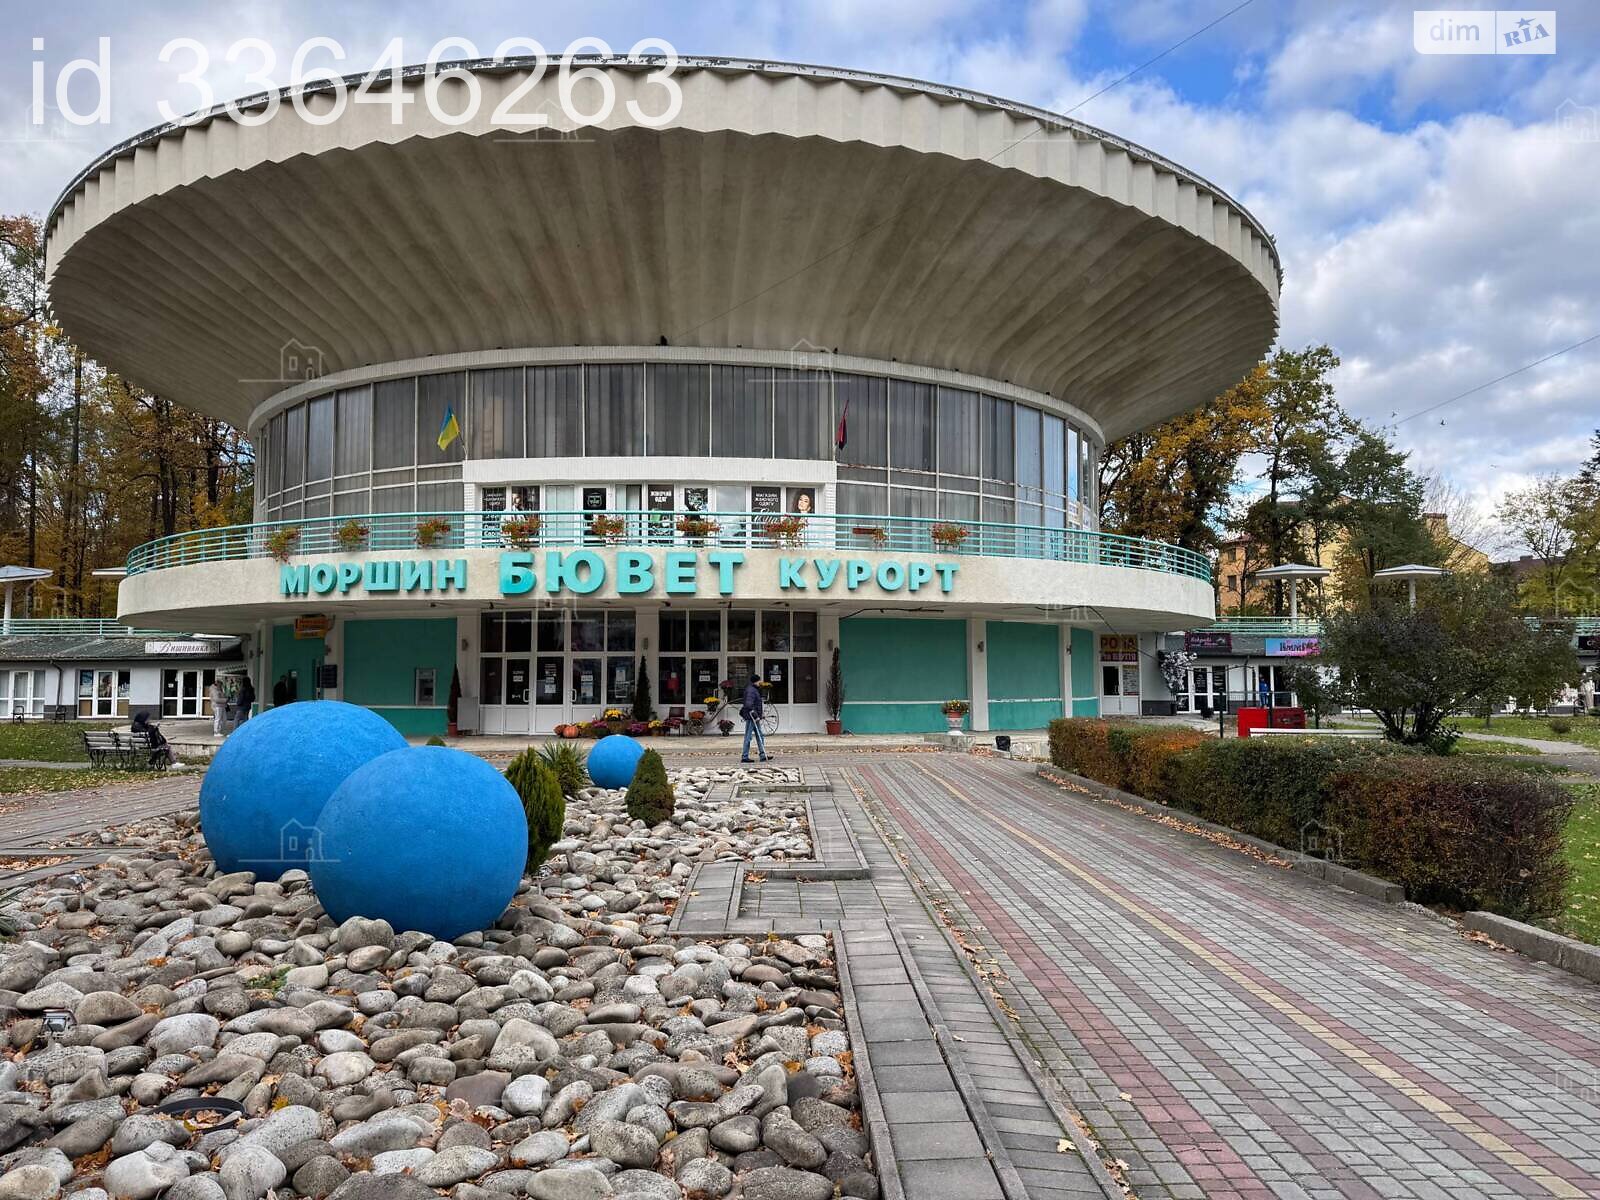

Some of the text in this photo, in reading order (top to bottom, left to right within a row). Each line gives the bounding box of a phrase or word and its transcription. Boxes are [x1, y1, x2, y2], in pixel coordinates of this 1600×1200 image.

[280, 552, 960, 595] МОРШИН БЮВЕТ КУРОРТ
